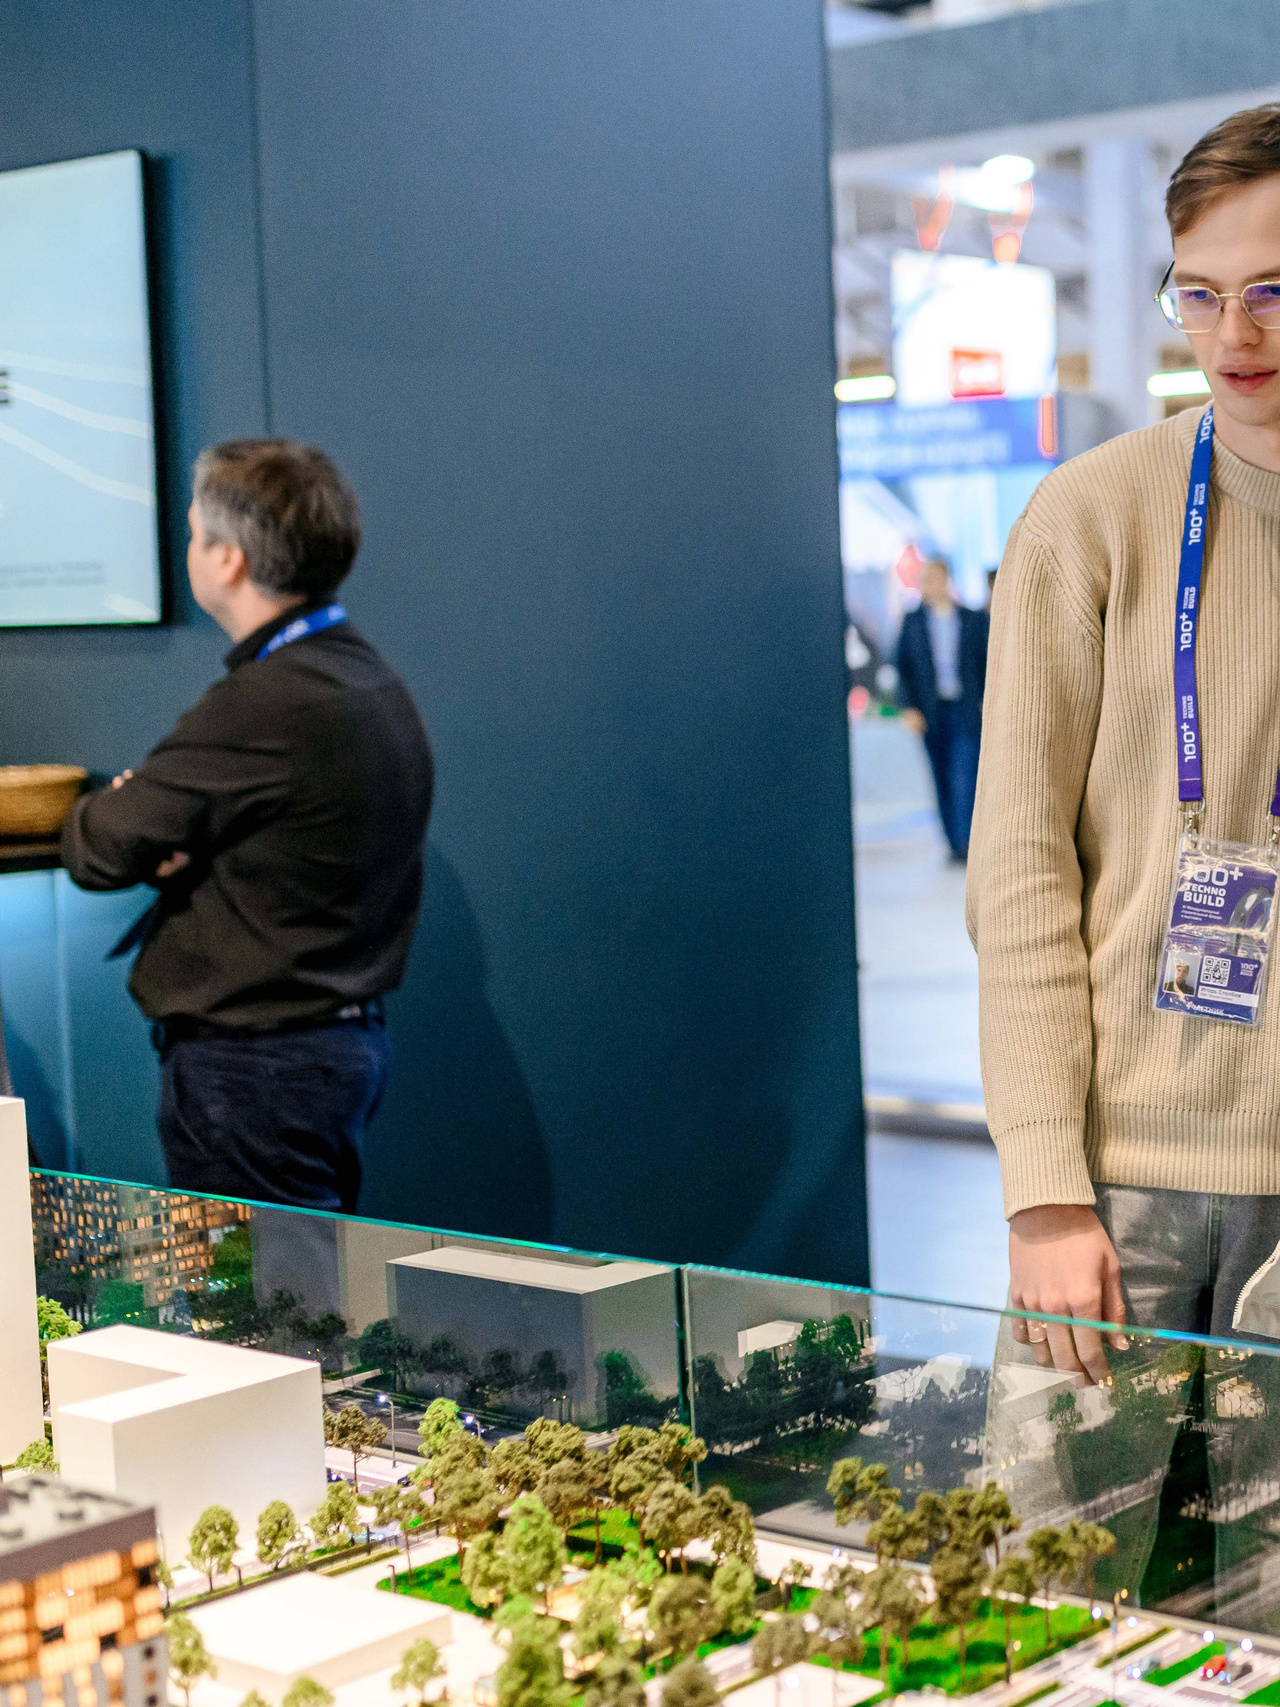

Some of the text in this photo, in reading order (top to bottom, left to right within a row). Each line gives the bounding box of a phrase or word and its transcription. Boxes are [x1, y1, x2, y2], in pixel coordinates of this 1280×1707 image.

[1188, 508, 1203, 546] 100+
[1188, 586, 1196, 609] BUILD
[1179, 612, 1193, 651] 100+
[1186, 695, 1195, 719] BUILD
[1180, 722, 1196, 762] 100+
[1183, 891, 1225, 908] BUILD
[1240, 962, 1259, 971] 100+
